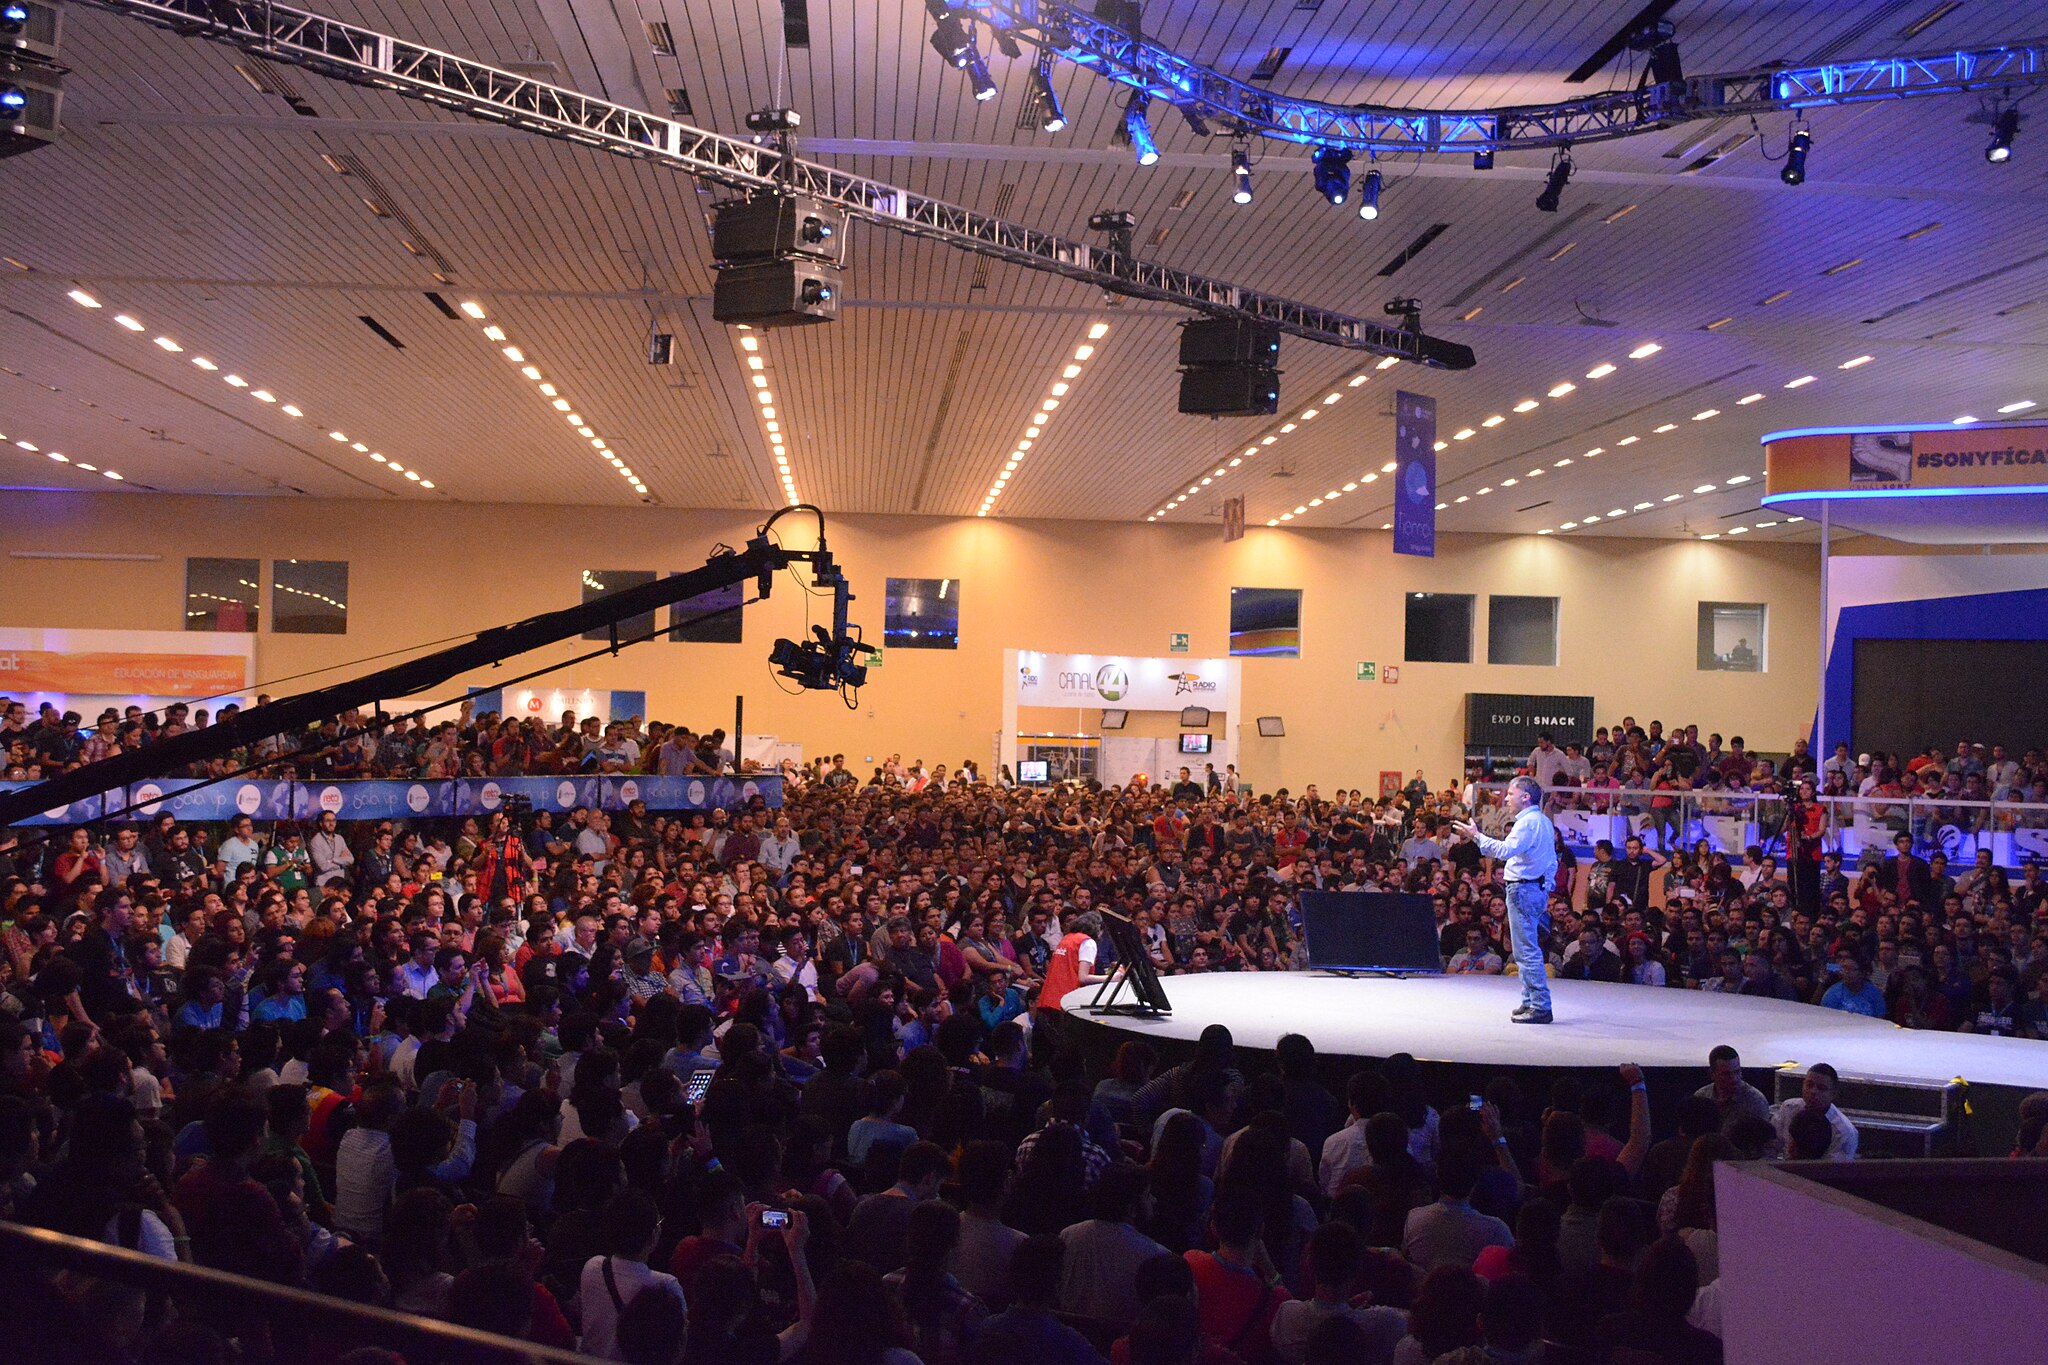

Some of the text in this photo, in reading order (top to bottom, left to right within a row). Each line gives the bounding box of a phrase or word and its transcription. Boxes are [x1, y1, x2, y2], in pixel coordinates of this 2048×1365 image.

[1917, 446, 2048, 468] #SONYFÍCA
[1059, 672, 1095, 690] CANAL
[1193, 681, 1216, 689] RADIO
[1491, 714, 1575, 726] EXPO SNACK
